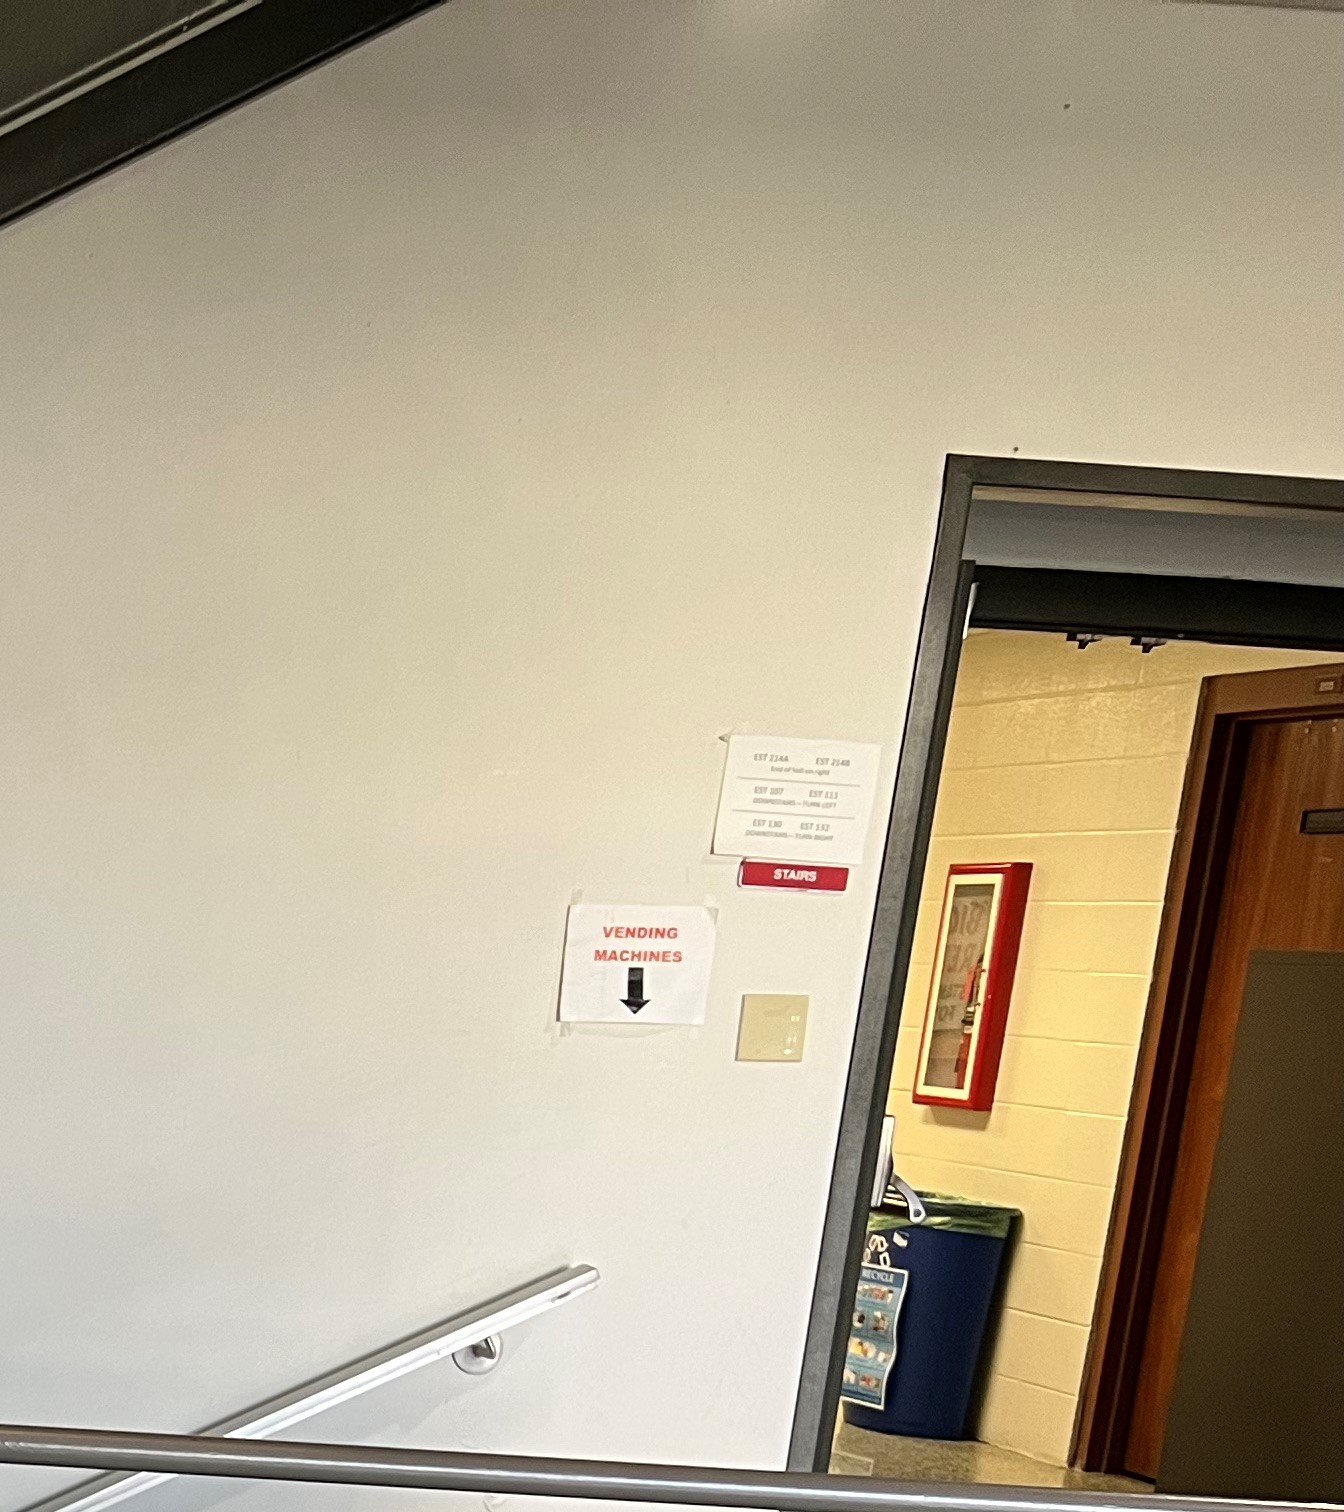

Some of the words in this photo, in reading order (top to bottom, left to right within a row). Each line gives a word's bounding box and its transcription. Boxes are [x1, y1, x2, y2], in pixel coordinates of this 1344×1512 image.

[754, 753, 768, 761] EST
[815, 757, 829, 766] EST
[754, 786, 768, 795] EST
[809, 790, 823, 798] EST
[753, 819, 767, 827] EST
[800, 822, 814, 830] EST
[773, 868, 817, 882] STAIRS
[603, 926, 678, 939] VENDING
[594, 949, 683, 963] MACHINES
